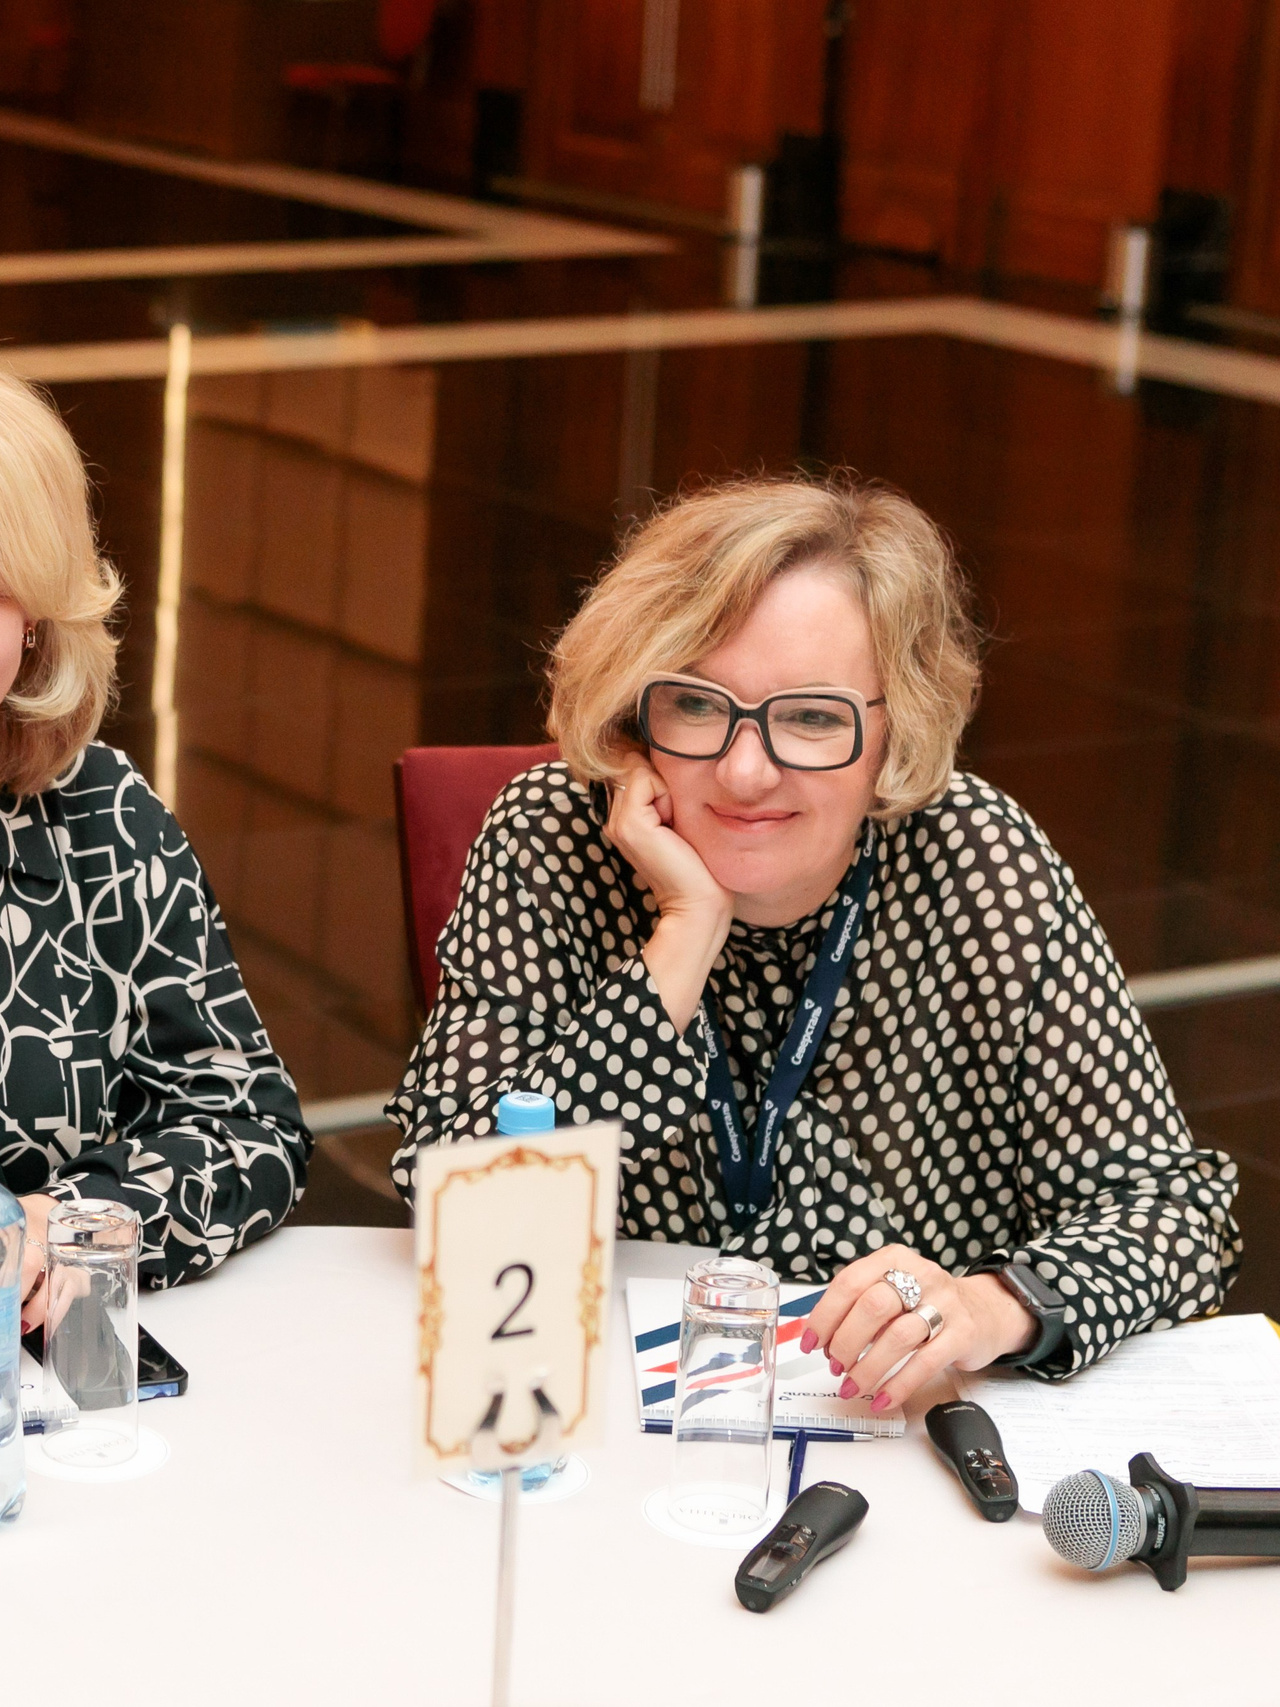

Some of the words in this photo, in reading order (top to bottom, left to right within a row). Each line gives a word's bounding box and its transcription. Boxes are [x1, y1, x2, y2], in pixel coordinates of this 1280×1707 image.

[830, 902, 860, 962] Северсталь
[791, 1006, 823, 1066] Северсталь
[722, 1102, 742, 1163] Северсталь
[759, 1107, 779, 1167] Северсталь
[490, 1262, 534, 1339] 2
